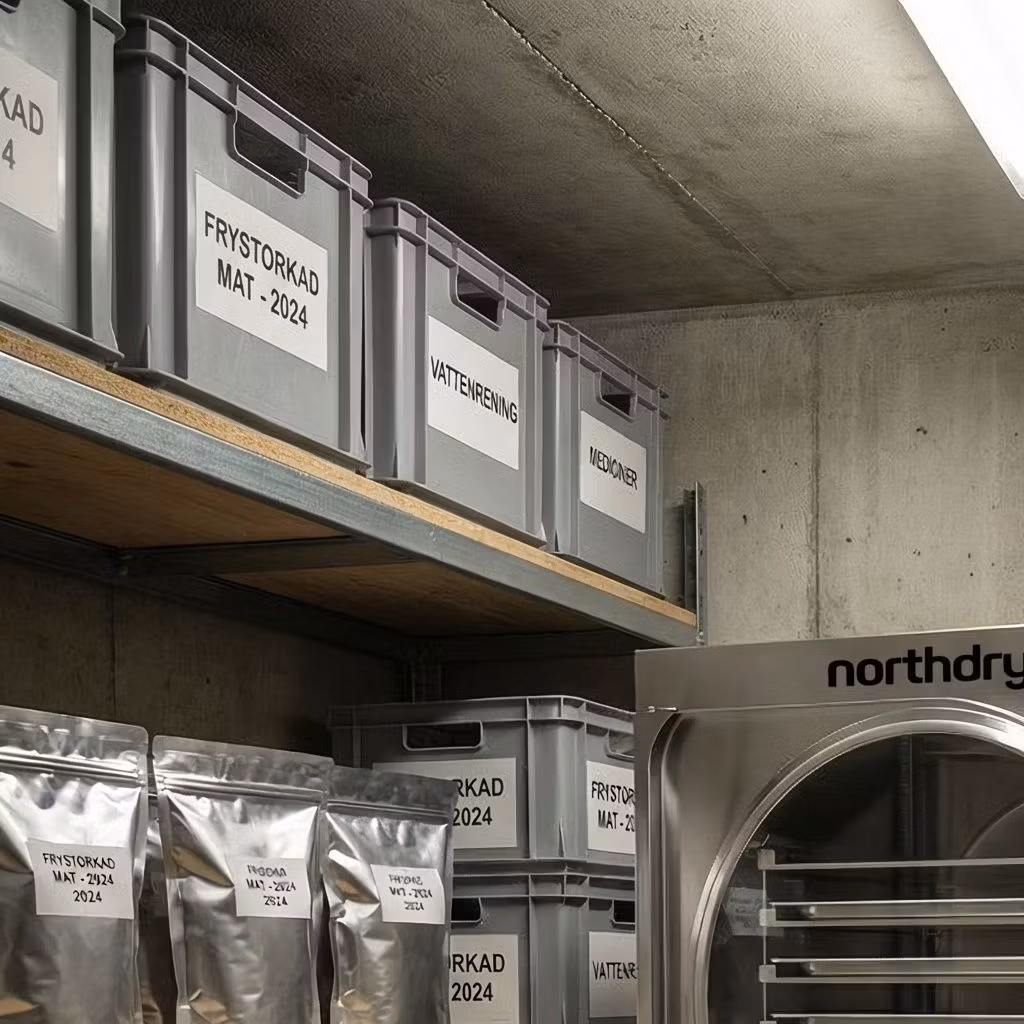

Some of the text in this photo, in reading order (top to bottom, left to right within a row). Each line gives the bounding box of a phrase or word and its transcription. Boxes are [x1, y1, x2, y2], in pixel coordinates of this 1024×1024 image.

[205, 210, 319, 296] FRYSTORKAD
[217, 257, 255, 301] MAT
[270, 288, 308, 330] 2024
[430, 355, 518, 424] VATTENRENING
[453, 806, 493, 827] 2024
[72, 889, 103, 903] 2024
[448, 953, 505, 973] RKAD
[451, 982, 494, 1002] 2024
